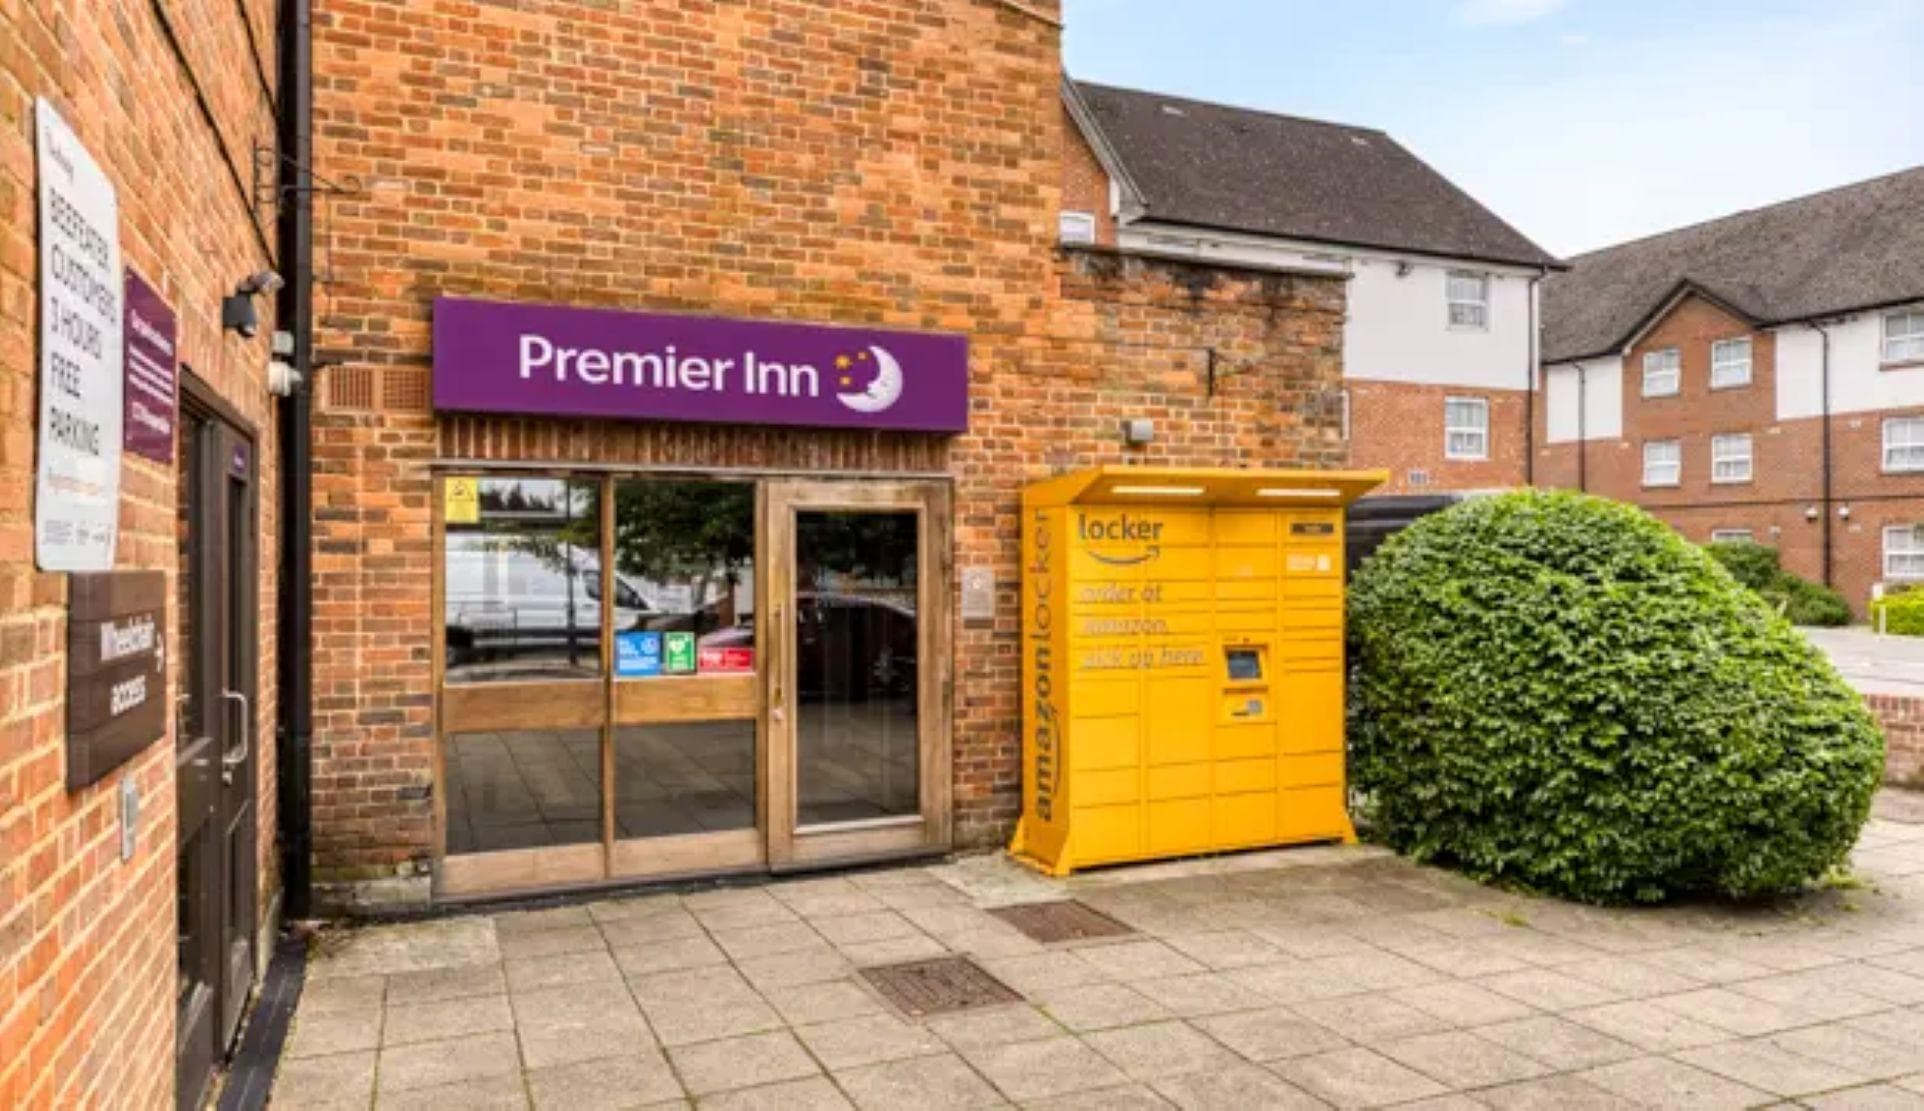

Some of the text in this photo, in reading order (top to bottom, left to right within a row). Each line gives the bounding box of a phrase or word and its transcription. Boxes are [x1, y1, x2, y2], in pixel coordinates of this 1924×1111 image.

[50, 351, 80, 398] FREE
[519, 334, 819, 397] Premier Inn
[50, 404, 100, 456] PARKING
[1078, 513, 1163, 541] locker
